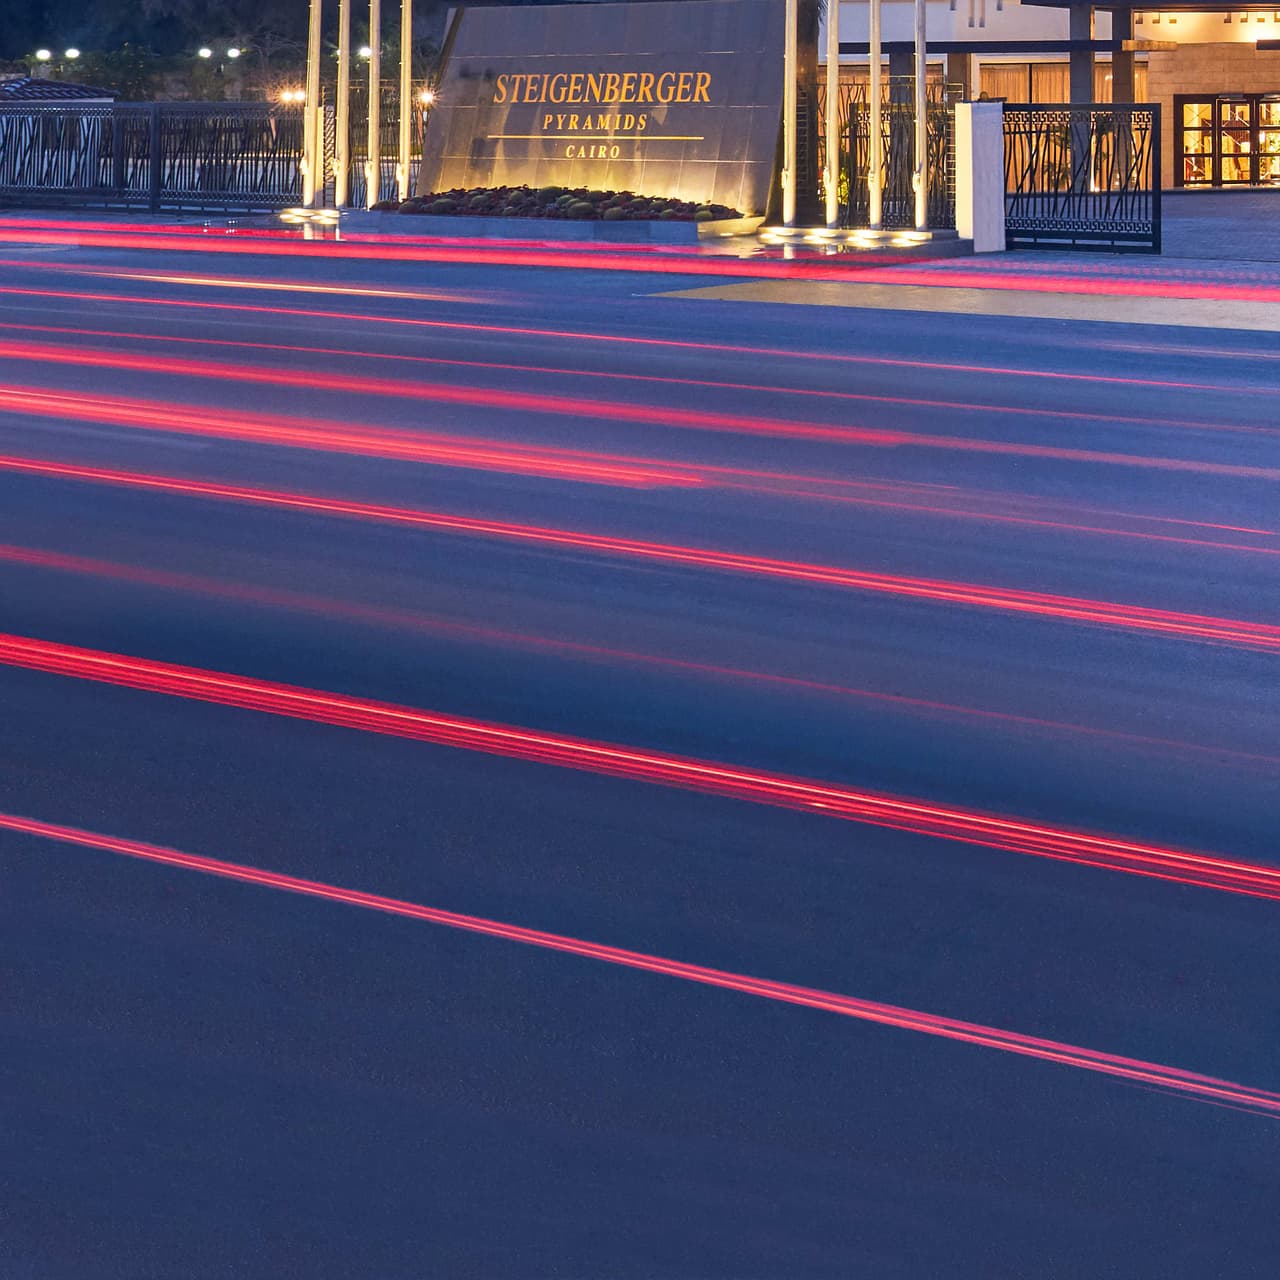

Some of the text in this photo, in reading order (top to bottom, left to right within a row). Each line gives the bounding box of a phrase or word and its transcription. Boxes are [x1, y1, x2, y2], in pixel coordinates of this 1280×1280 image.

[493, 72, 711, 104] STEIGENBERGER
[543, 113, 647, 131] PYRAMIDS
[566, 144, 620, 158] CAIRO
